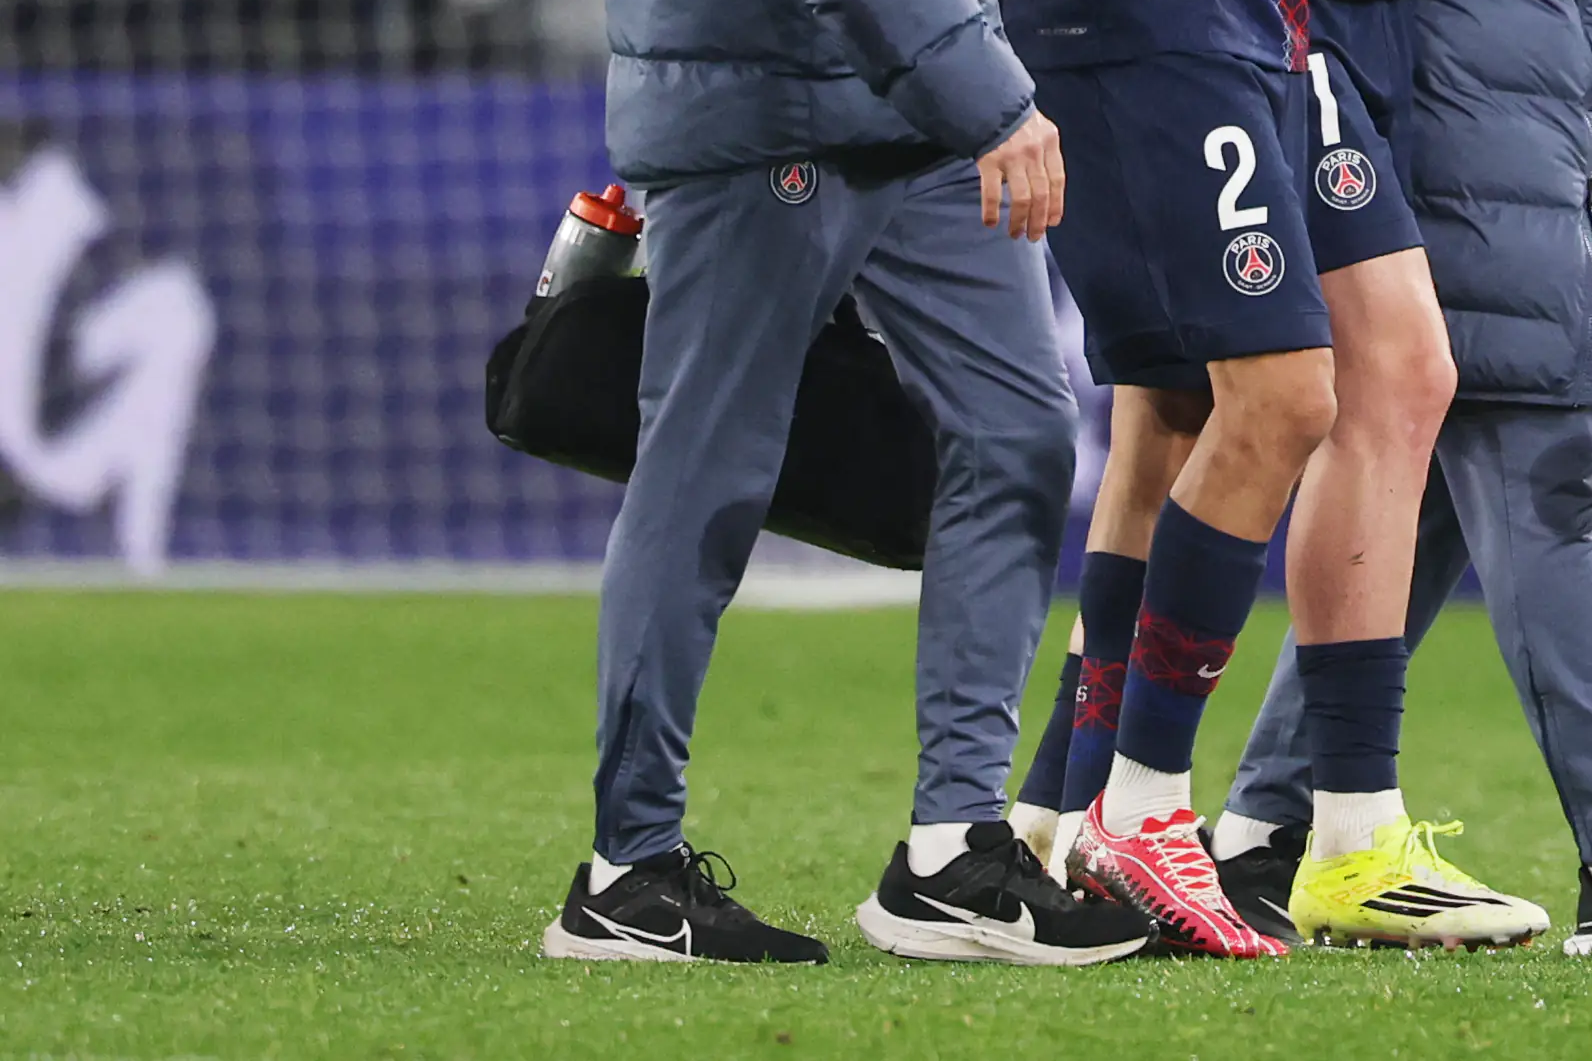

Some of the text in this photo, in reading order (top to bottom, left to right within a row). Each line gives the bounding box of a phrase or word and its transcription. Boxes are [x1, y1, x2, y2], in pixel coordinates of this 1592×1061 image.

[1322, 151, 1361, 171] PARIS
[1203, 125, 1268, 232] 2
[1230, 234, 1271, 254] PARIS
